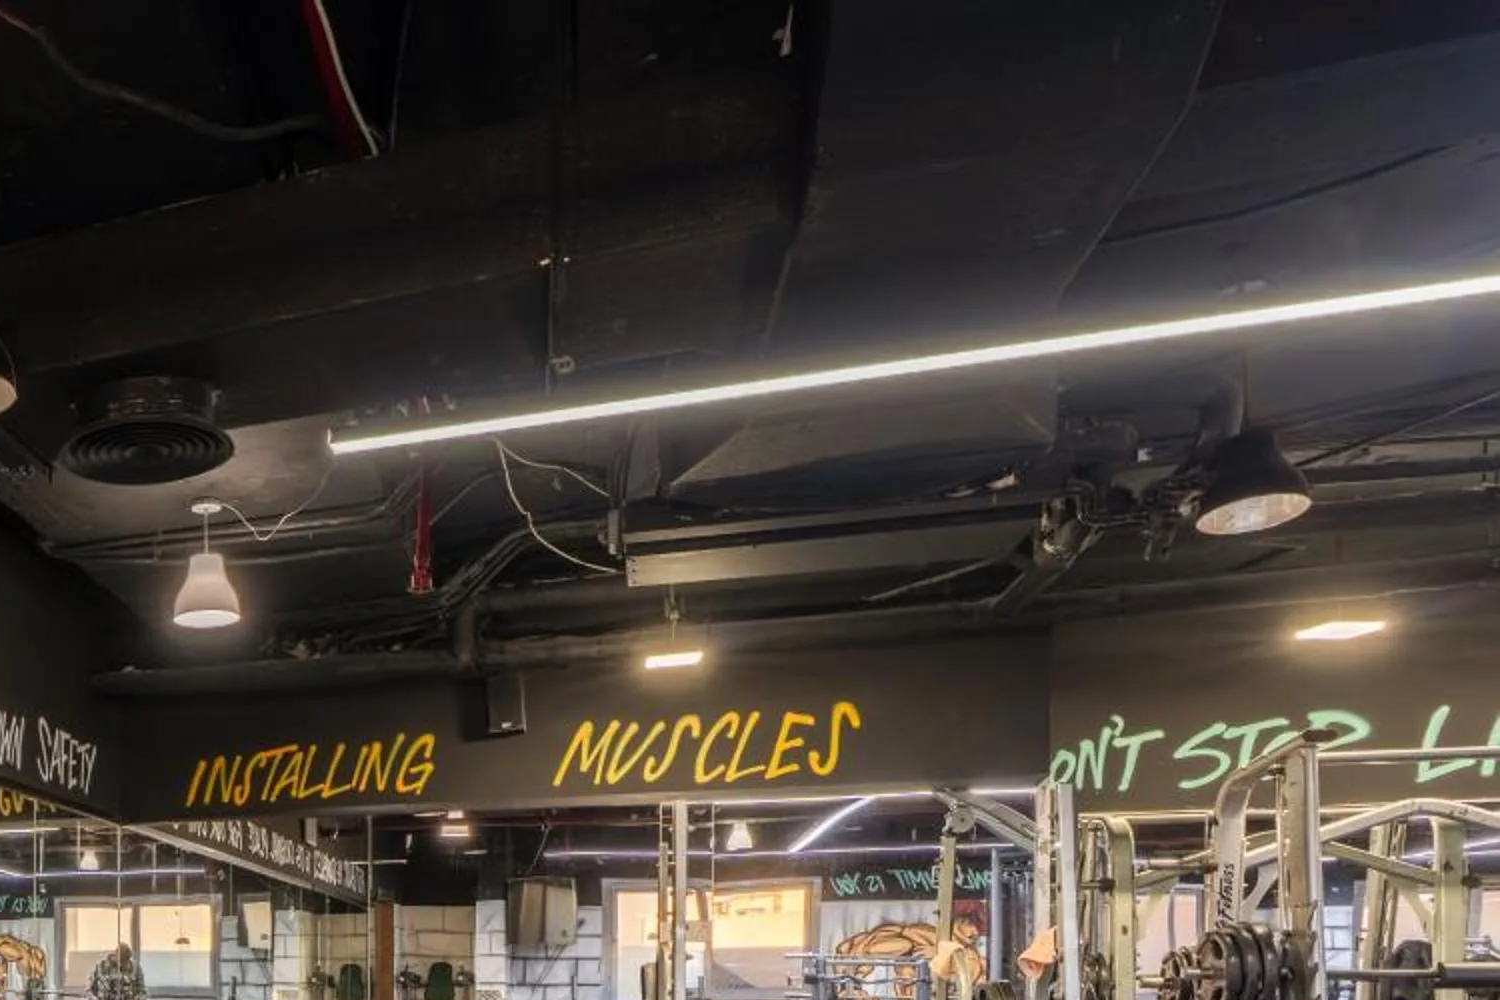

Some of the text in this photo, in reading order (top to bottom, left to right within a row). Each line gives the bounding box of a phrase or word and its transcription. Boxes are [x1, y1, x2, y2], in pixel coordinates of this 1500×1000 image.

[36, 717, 97, 794] SAFETY
[185, 701, 861, 808] INSTALLING MUSCLES
